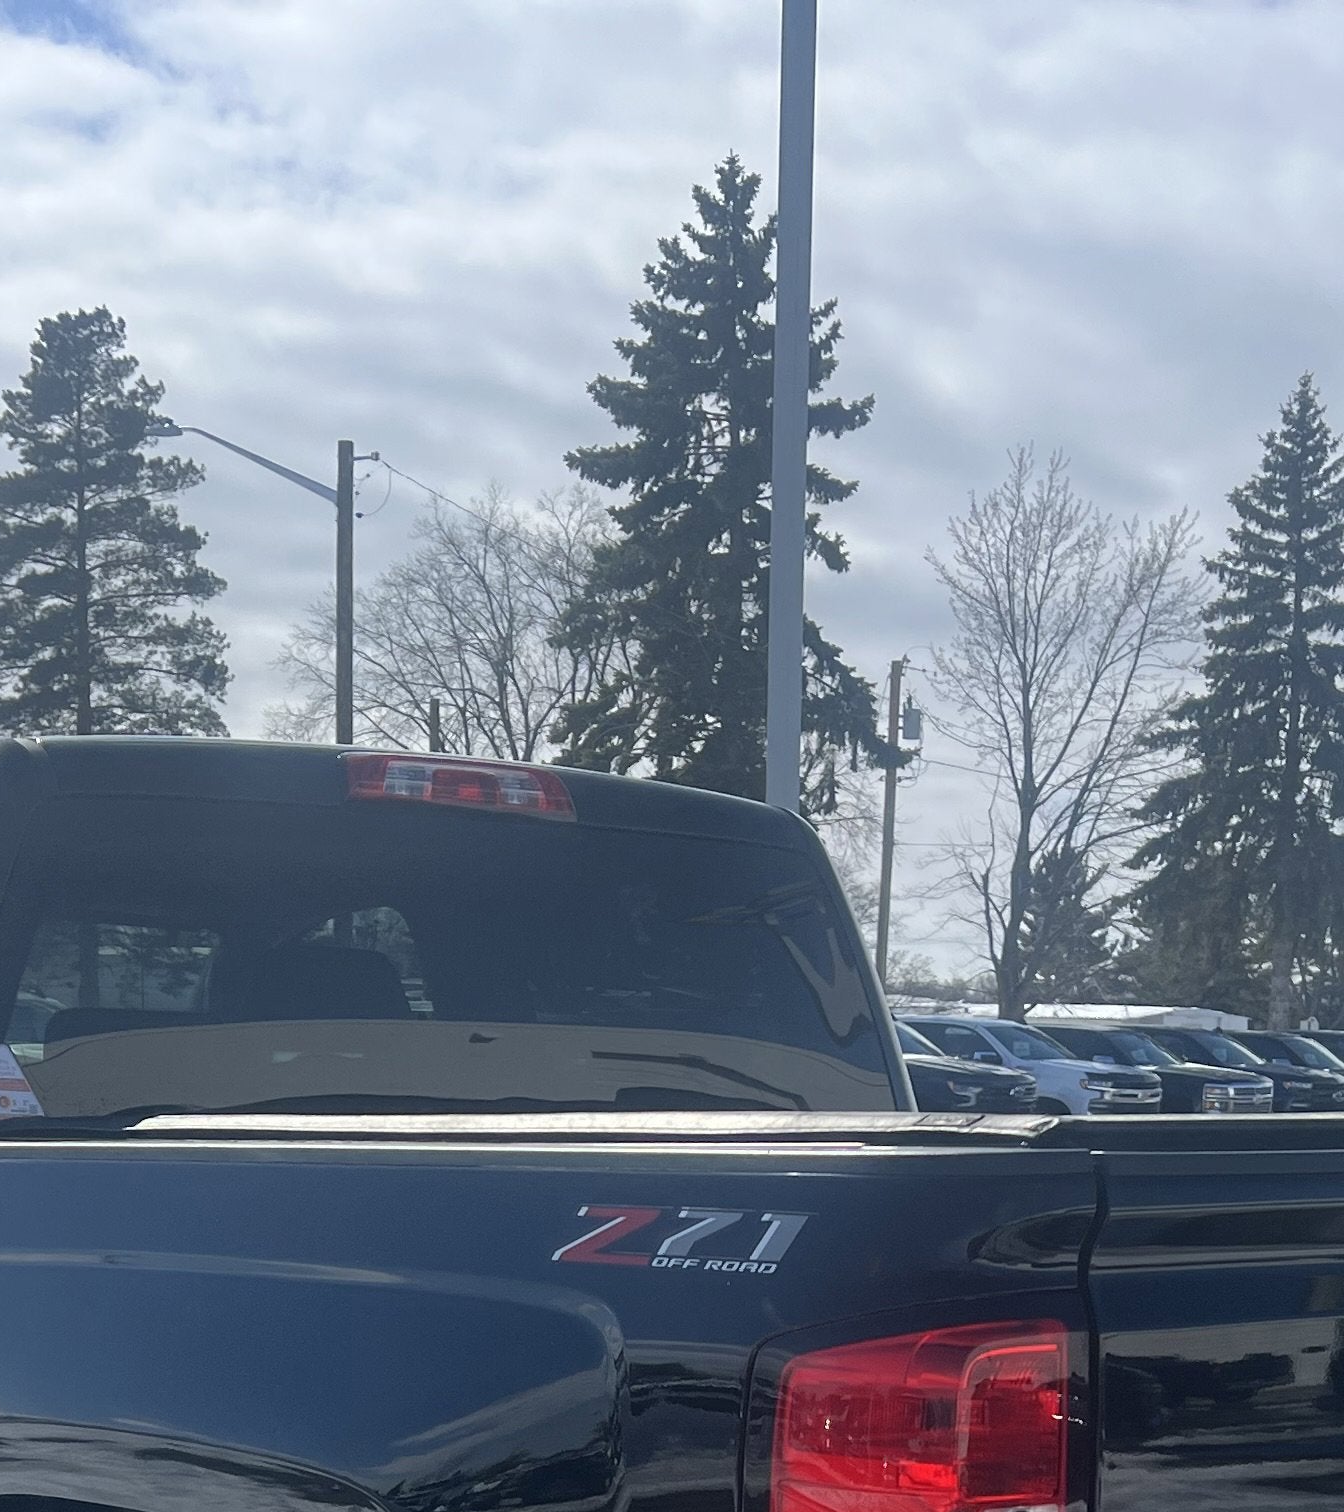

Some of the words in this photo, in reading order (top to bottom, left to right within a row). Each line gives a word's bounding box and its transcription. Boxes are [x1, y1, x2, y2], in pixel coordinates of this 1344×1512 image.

[551, 1205, 809, 1267] Z71
[651, 1256, 700, 1269] OFF
[704, 1259, 778, 1275] ROAD
